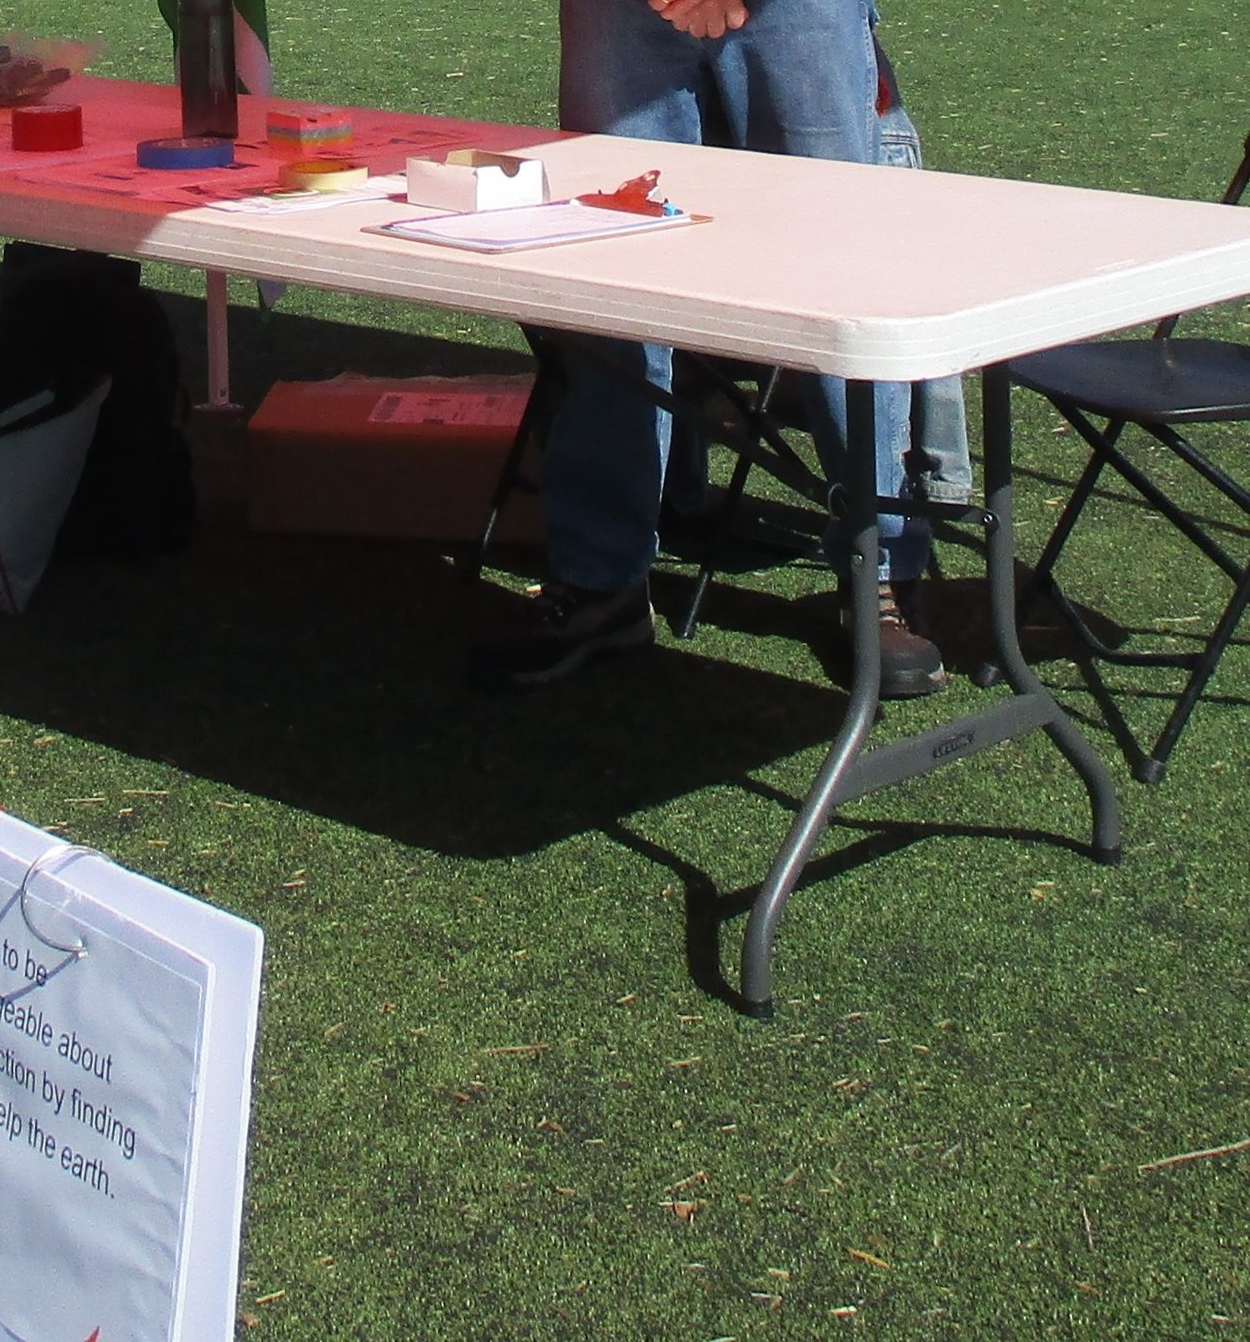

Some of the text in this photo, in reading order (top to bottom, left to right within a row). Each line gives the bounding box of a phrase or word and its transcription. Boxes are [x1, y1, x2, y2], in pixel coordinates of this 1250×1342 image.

[3, 939, 19, 971] to
[25, 950, 47, 987] be
[58, 1032, 113, 1083] about
[42, 1070, 65, 1115] by
[71, 1088, 136, 1159] finding
[28, 1118, 56, 1158] the
[61, 1146, 115, 1199] earth.
